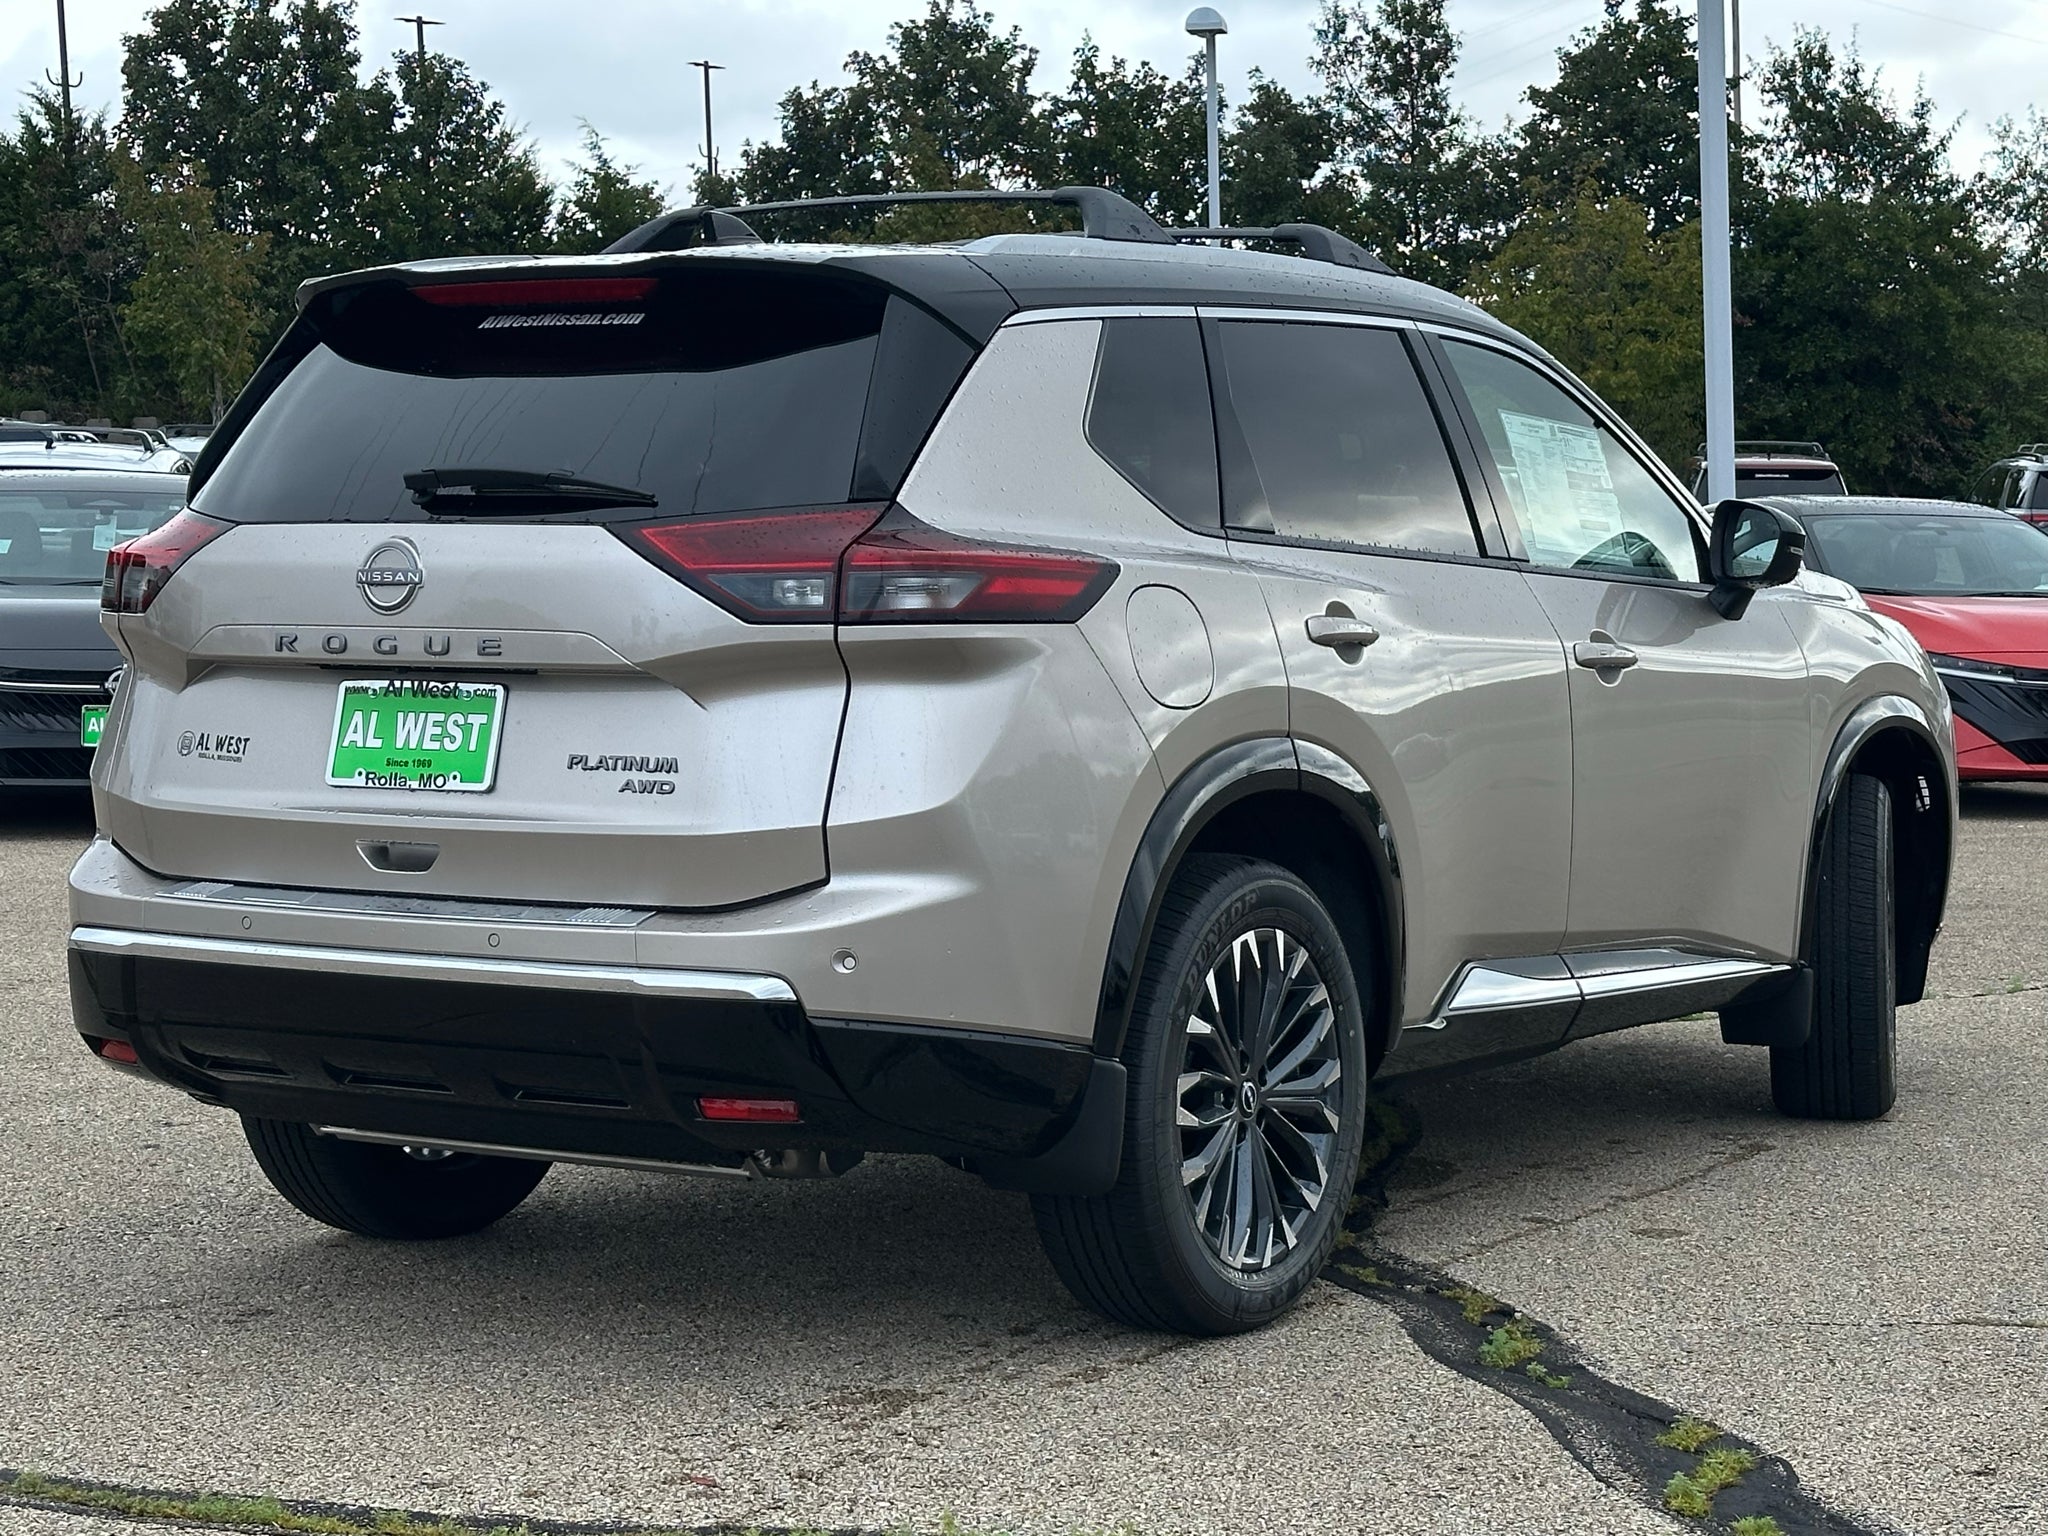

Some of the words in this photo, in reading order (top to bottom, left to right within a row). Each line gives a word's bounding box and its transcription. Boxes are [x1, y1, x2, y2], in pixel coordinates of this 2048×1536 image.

[478, 313, 645, 329] AlWestNissan.com
[357, 571, 420, 582] NISSAN
[275, 633, 502, 656] ROGUE
[412, 680, 459, 699] West
[341, 710, 383, 748] AL
[396, 711, 488, 752] WEST
[196, 732, 210, 751] AL
[216, 735, 250, 755] WEST
[385, 758, 409, 767] Since
[412, 759, 432, 768] 1969
[567, 754, 679, 774] PLATINUM
[365, 771, 412, 790] Rolla,
[418, 773, 447, 789] MO
[618, 779, 676, 795] AWD
[1185, 890, 1259, 996] DUNLOP
